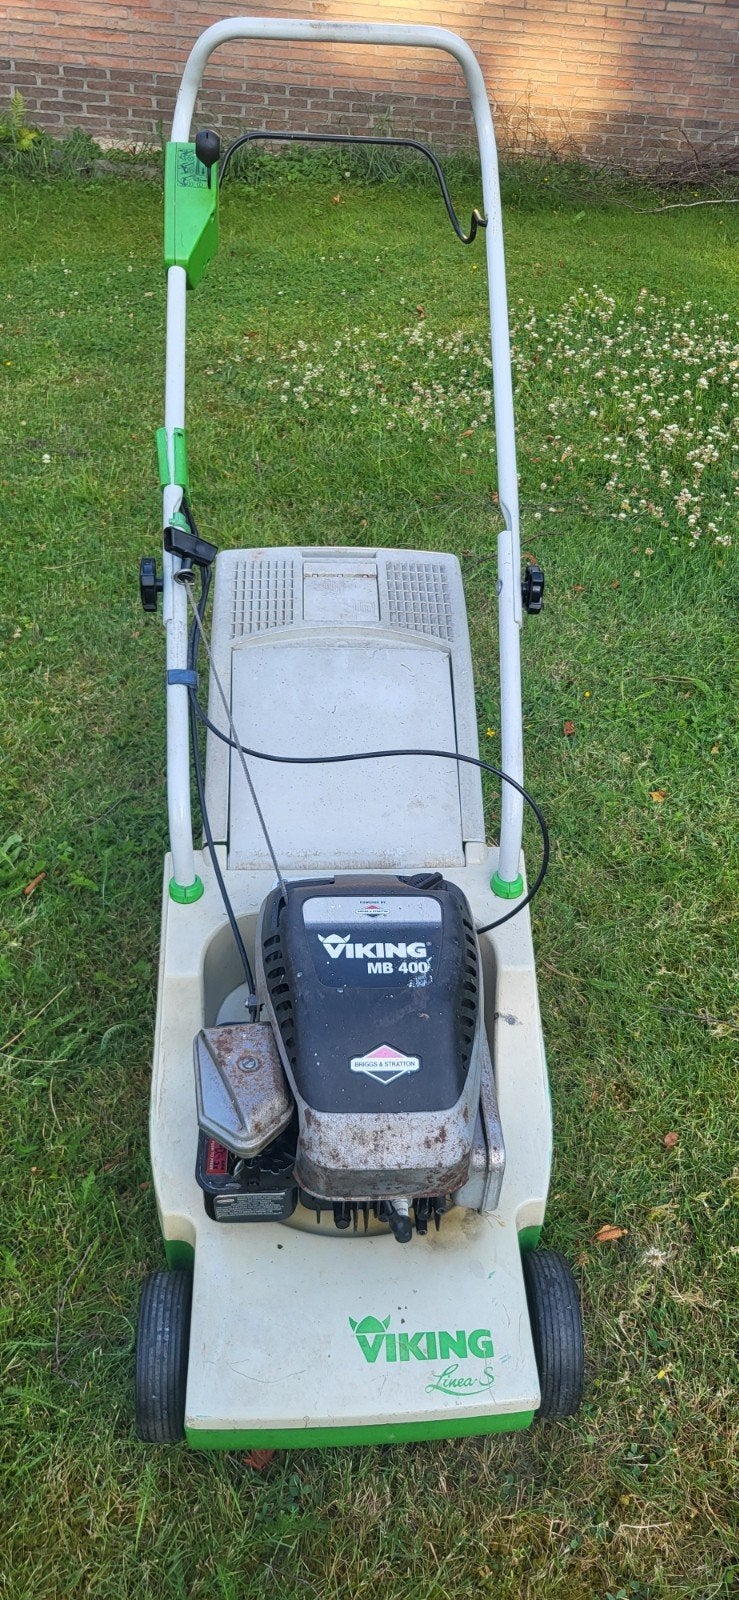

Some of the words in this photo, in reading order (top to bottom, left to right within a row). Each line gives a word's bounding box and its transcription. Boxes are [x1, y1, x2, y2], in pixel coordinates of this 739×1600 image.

[322, 942, 427, 959] VIKING
[367, 962, 394, 974] MB
[398, 961, 428, 974] 400
[384, 1059, 416, 1067] STRATTON
[356, 1328, 495, 1363] VIKING
